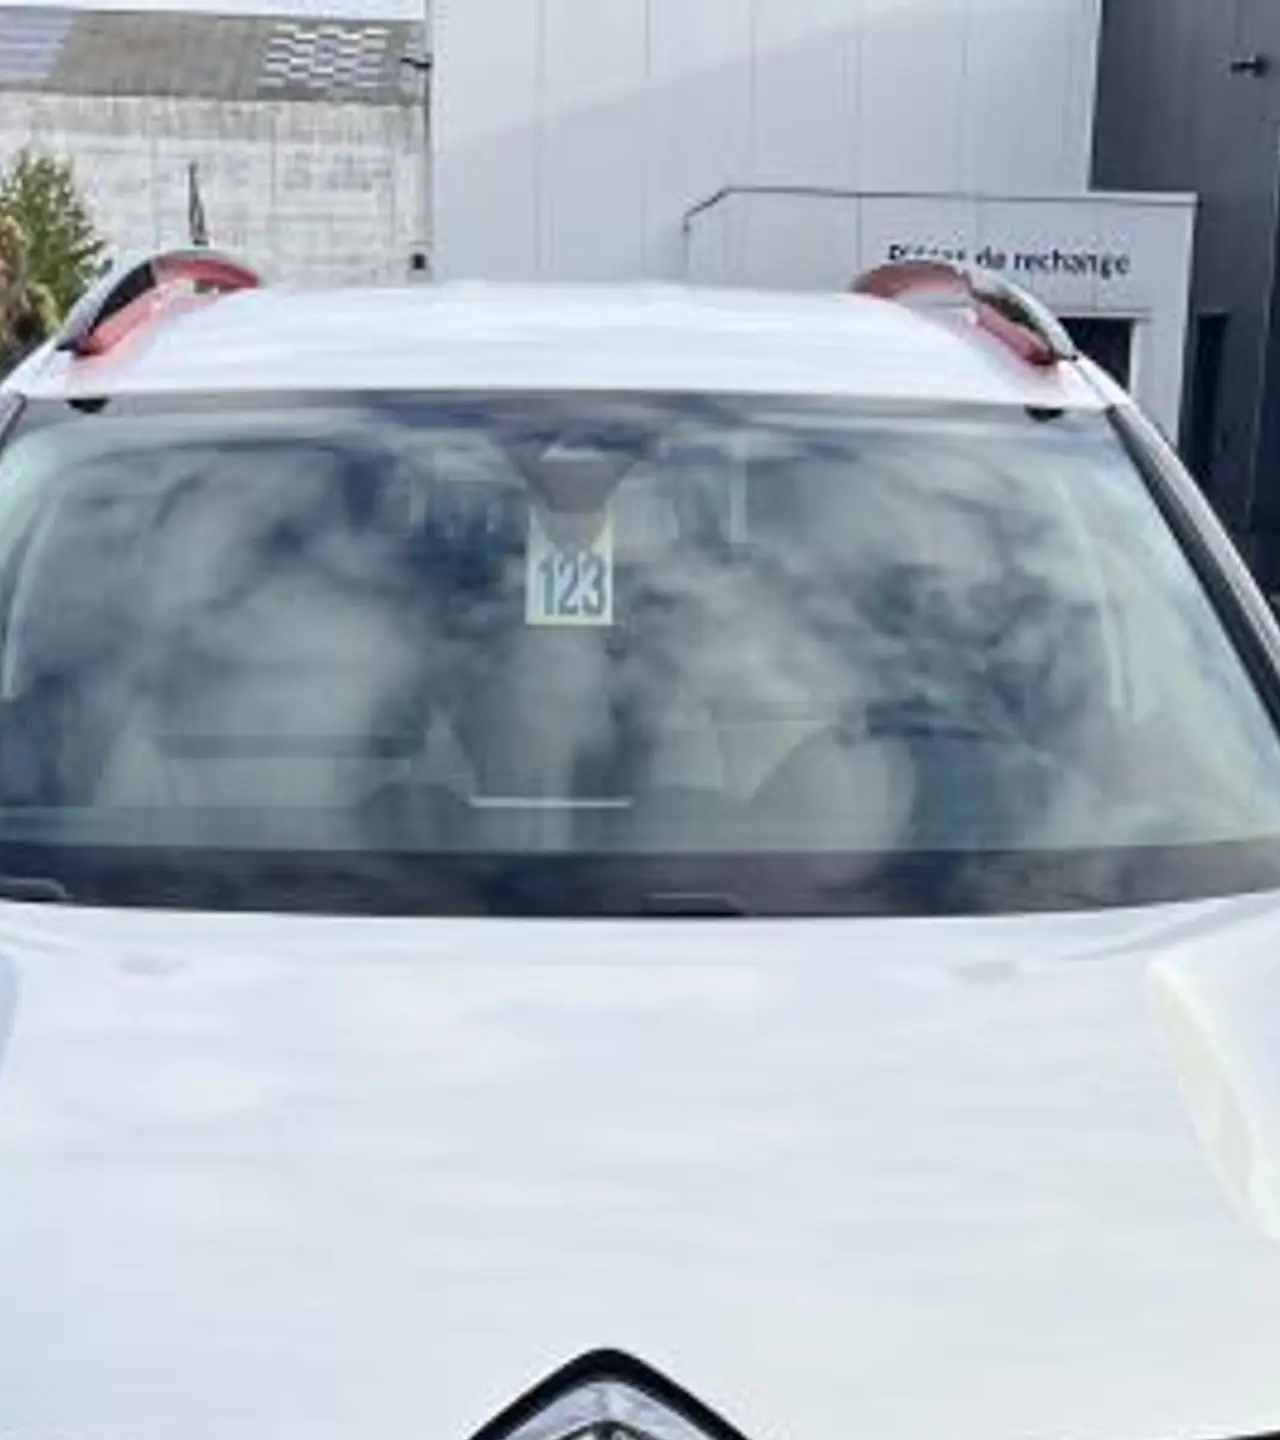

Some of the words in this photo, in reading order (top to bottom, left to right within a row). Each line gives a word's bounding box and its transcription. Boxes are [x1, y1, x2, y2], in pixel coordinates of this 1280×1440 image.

[975, 245, 1007, 270] de
[1014, 248, 1131, 280] rechange
[537, 550, 607, 616] 123
